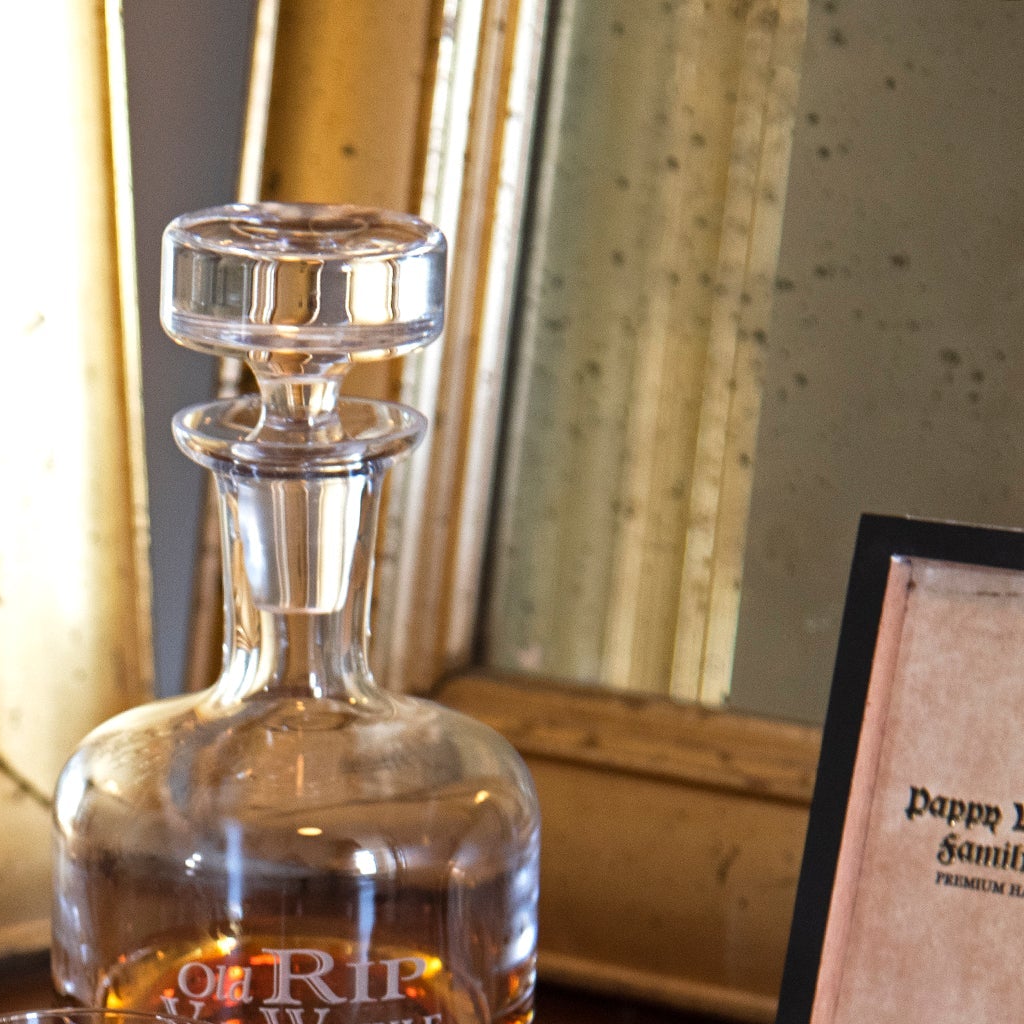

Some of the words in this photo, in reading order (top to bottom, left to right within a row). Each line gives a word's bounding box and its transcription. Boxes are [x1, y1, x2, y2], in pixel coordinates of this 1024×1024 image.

[904, 785, 1002, 834] Pappy
[936, 832, 1024, 874] Famil
[935, 871, 1005, 895] PREMIUM
[177, 961, 254, 1004] Old
[261, 947, 427, 1006] RIP
